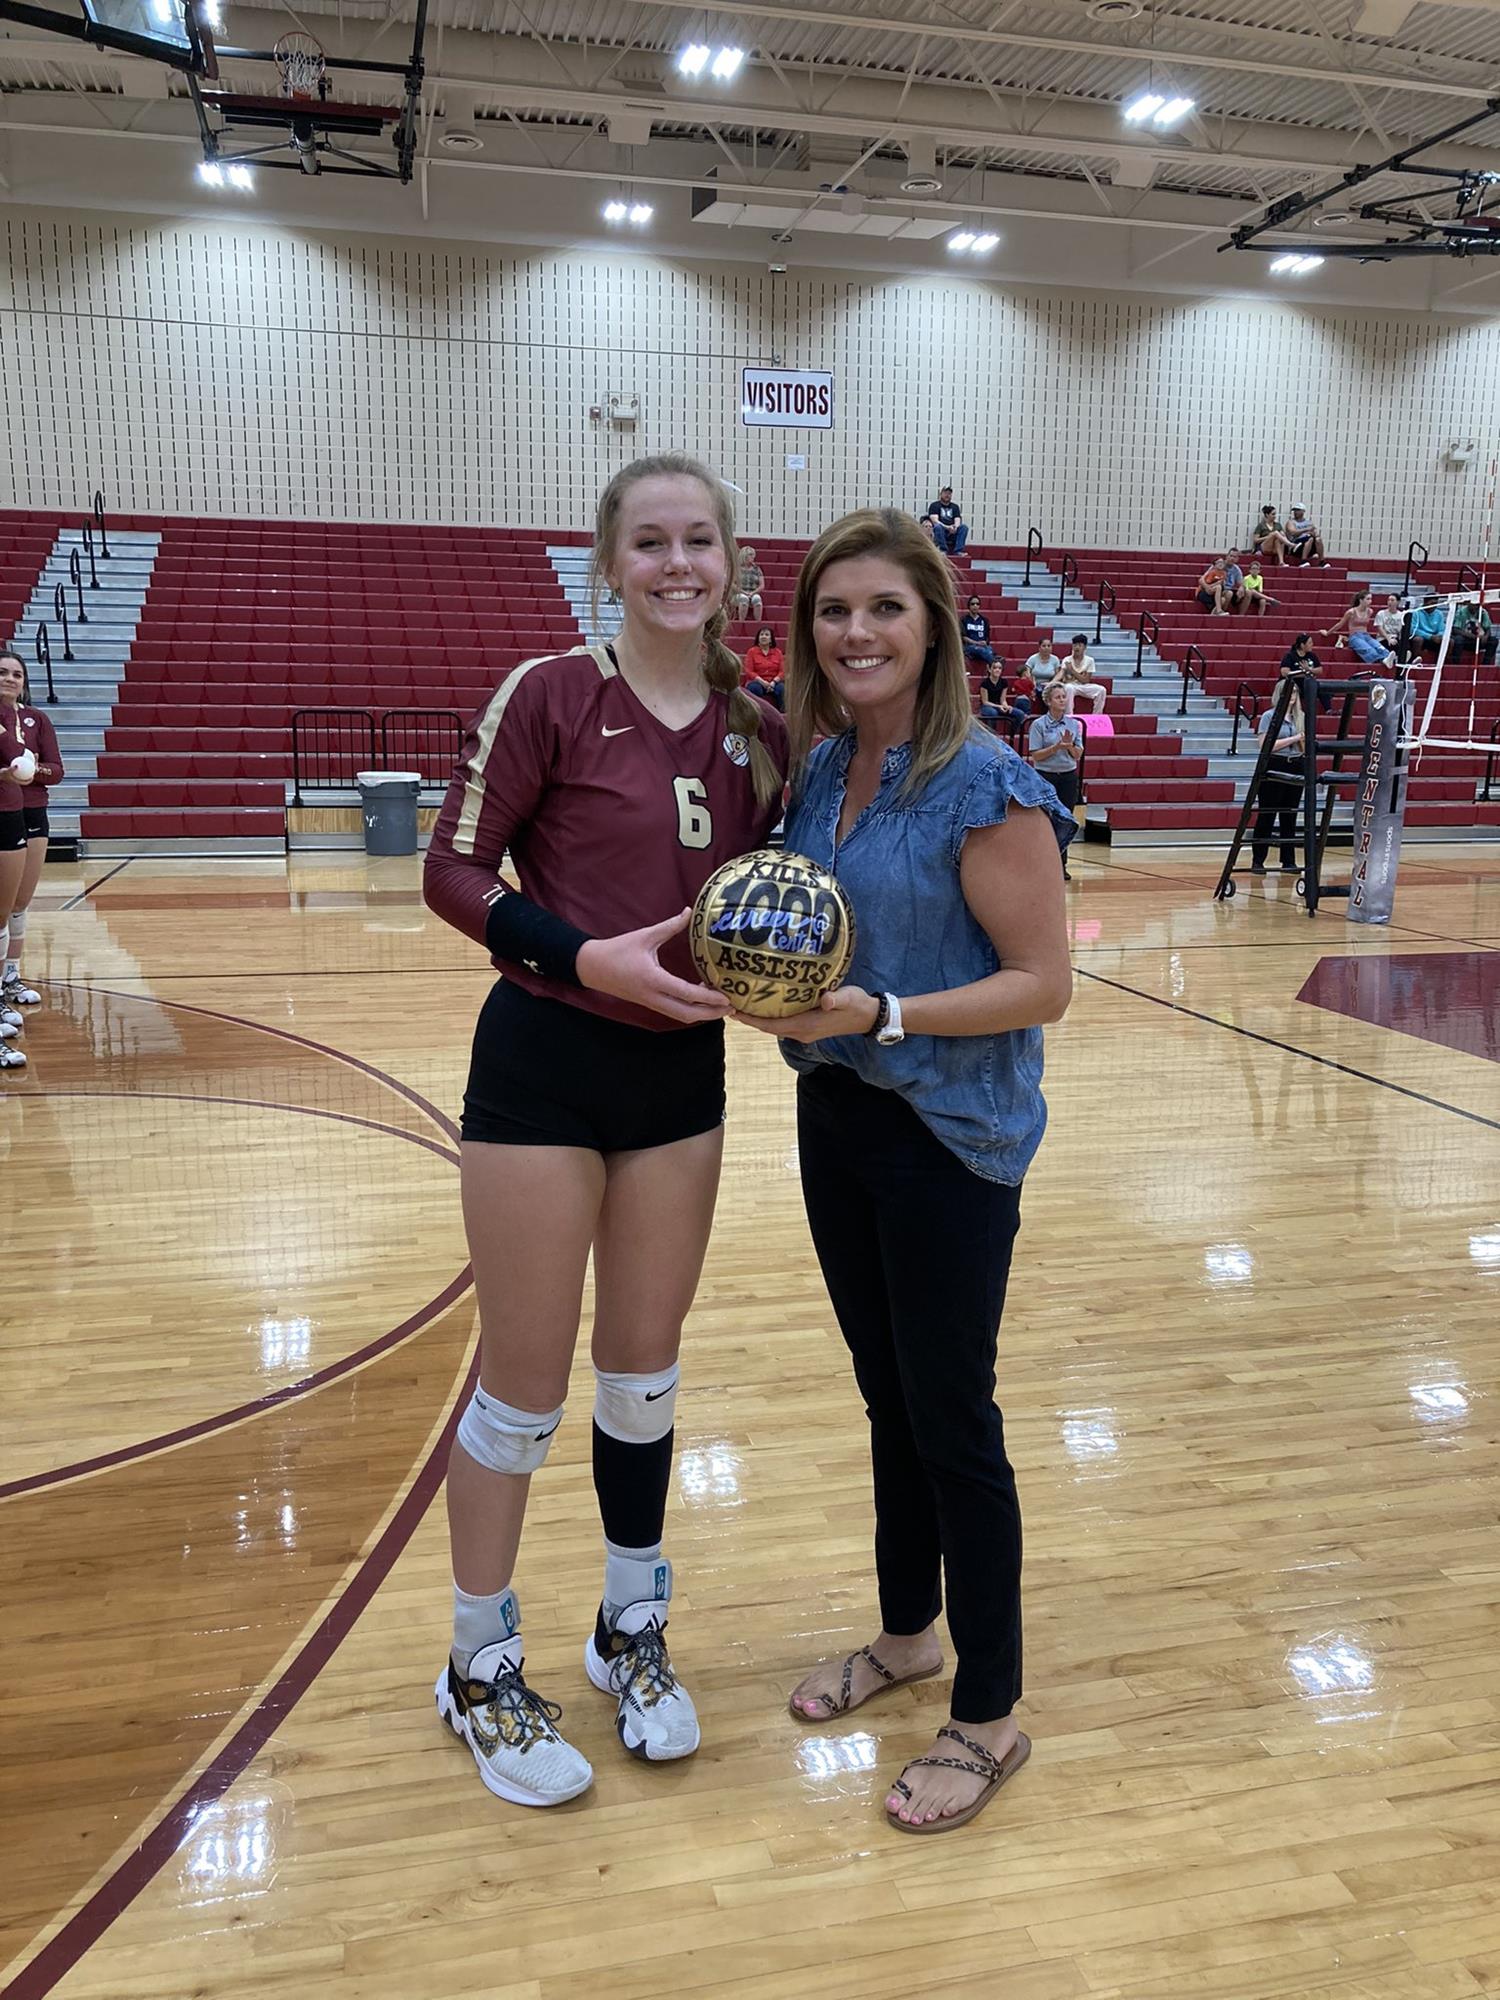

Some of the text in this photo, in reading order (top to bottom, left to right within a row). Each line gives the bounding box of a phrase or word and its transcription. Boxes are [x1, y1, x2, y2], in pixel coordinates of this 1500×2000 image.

[747, 381, 829, 415] VISITORS
[673, 775, 712, 849] 6
[1352, 723, 1382, 908] CENTRAL
[745, 860, 821, 888] KILLS
[707, 877, 841, 956] 1000
[710, 909, 811, 934] career
[768, 928, 824, 956] Central
[716, 946, 832, 985] ASSISTS
[721, 977, 813, 1003] 20 23
